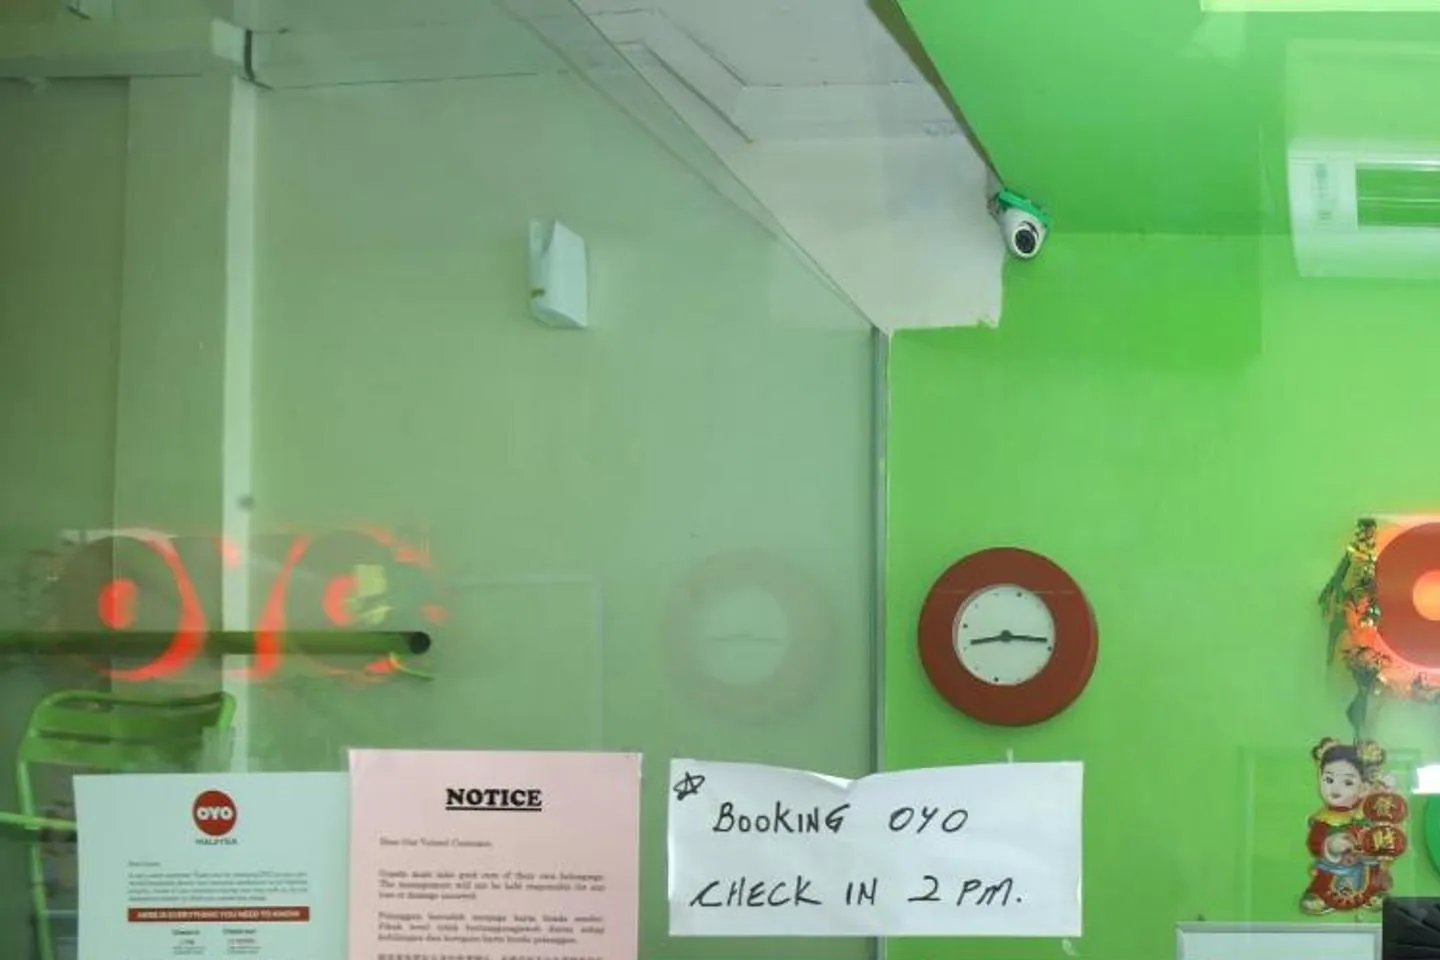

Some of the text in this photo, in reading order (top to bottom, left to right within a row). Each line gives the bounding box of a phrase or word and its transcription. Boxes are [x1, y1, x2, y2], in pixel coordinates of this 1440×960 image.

[446, 788, 542, 807] NOTICE
[197, 806, 233, 820] OYO
[888, 806, 968, 833] OYO
[690, 876, 822, 908] CHECK
[846, 878, 878, 905] IN
[908, 876, 941, 904] 2
